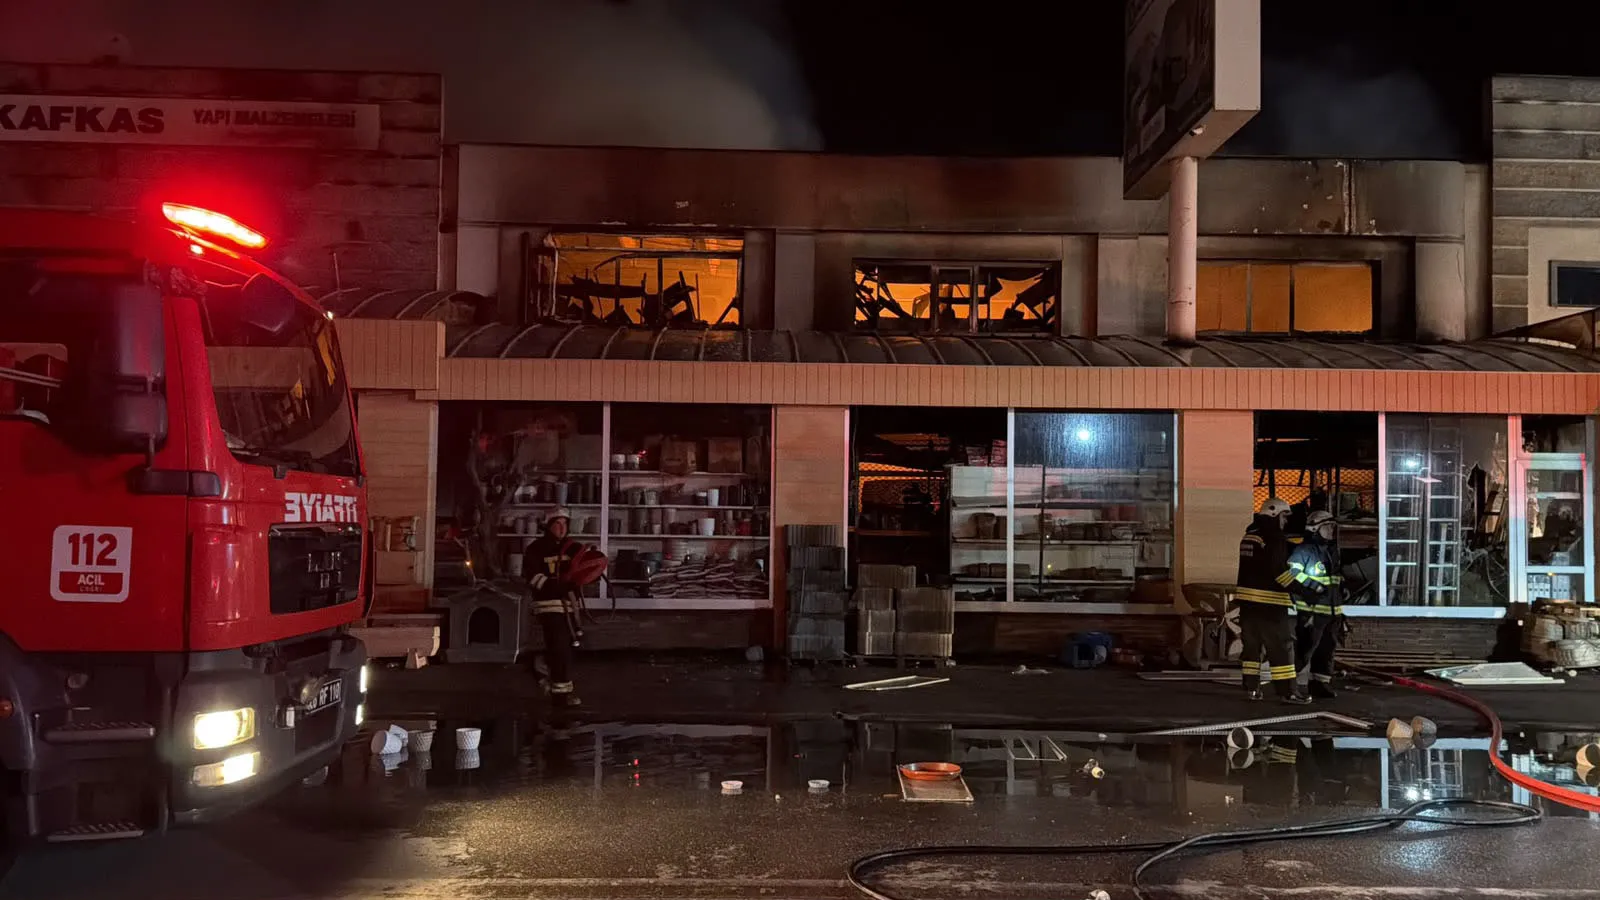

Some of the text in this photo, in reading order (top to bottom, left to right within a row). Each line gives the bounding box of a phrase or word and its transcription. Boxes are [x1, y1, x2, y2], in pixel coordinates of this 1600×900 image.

[0, 104, 165, 134] KAFKAS
[193, 108, 231, 125] YAPI
[68, 532, 117, 566] 112
